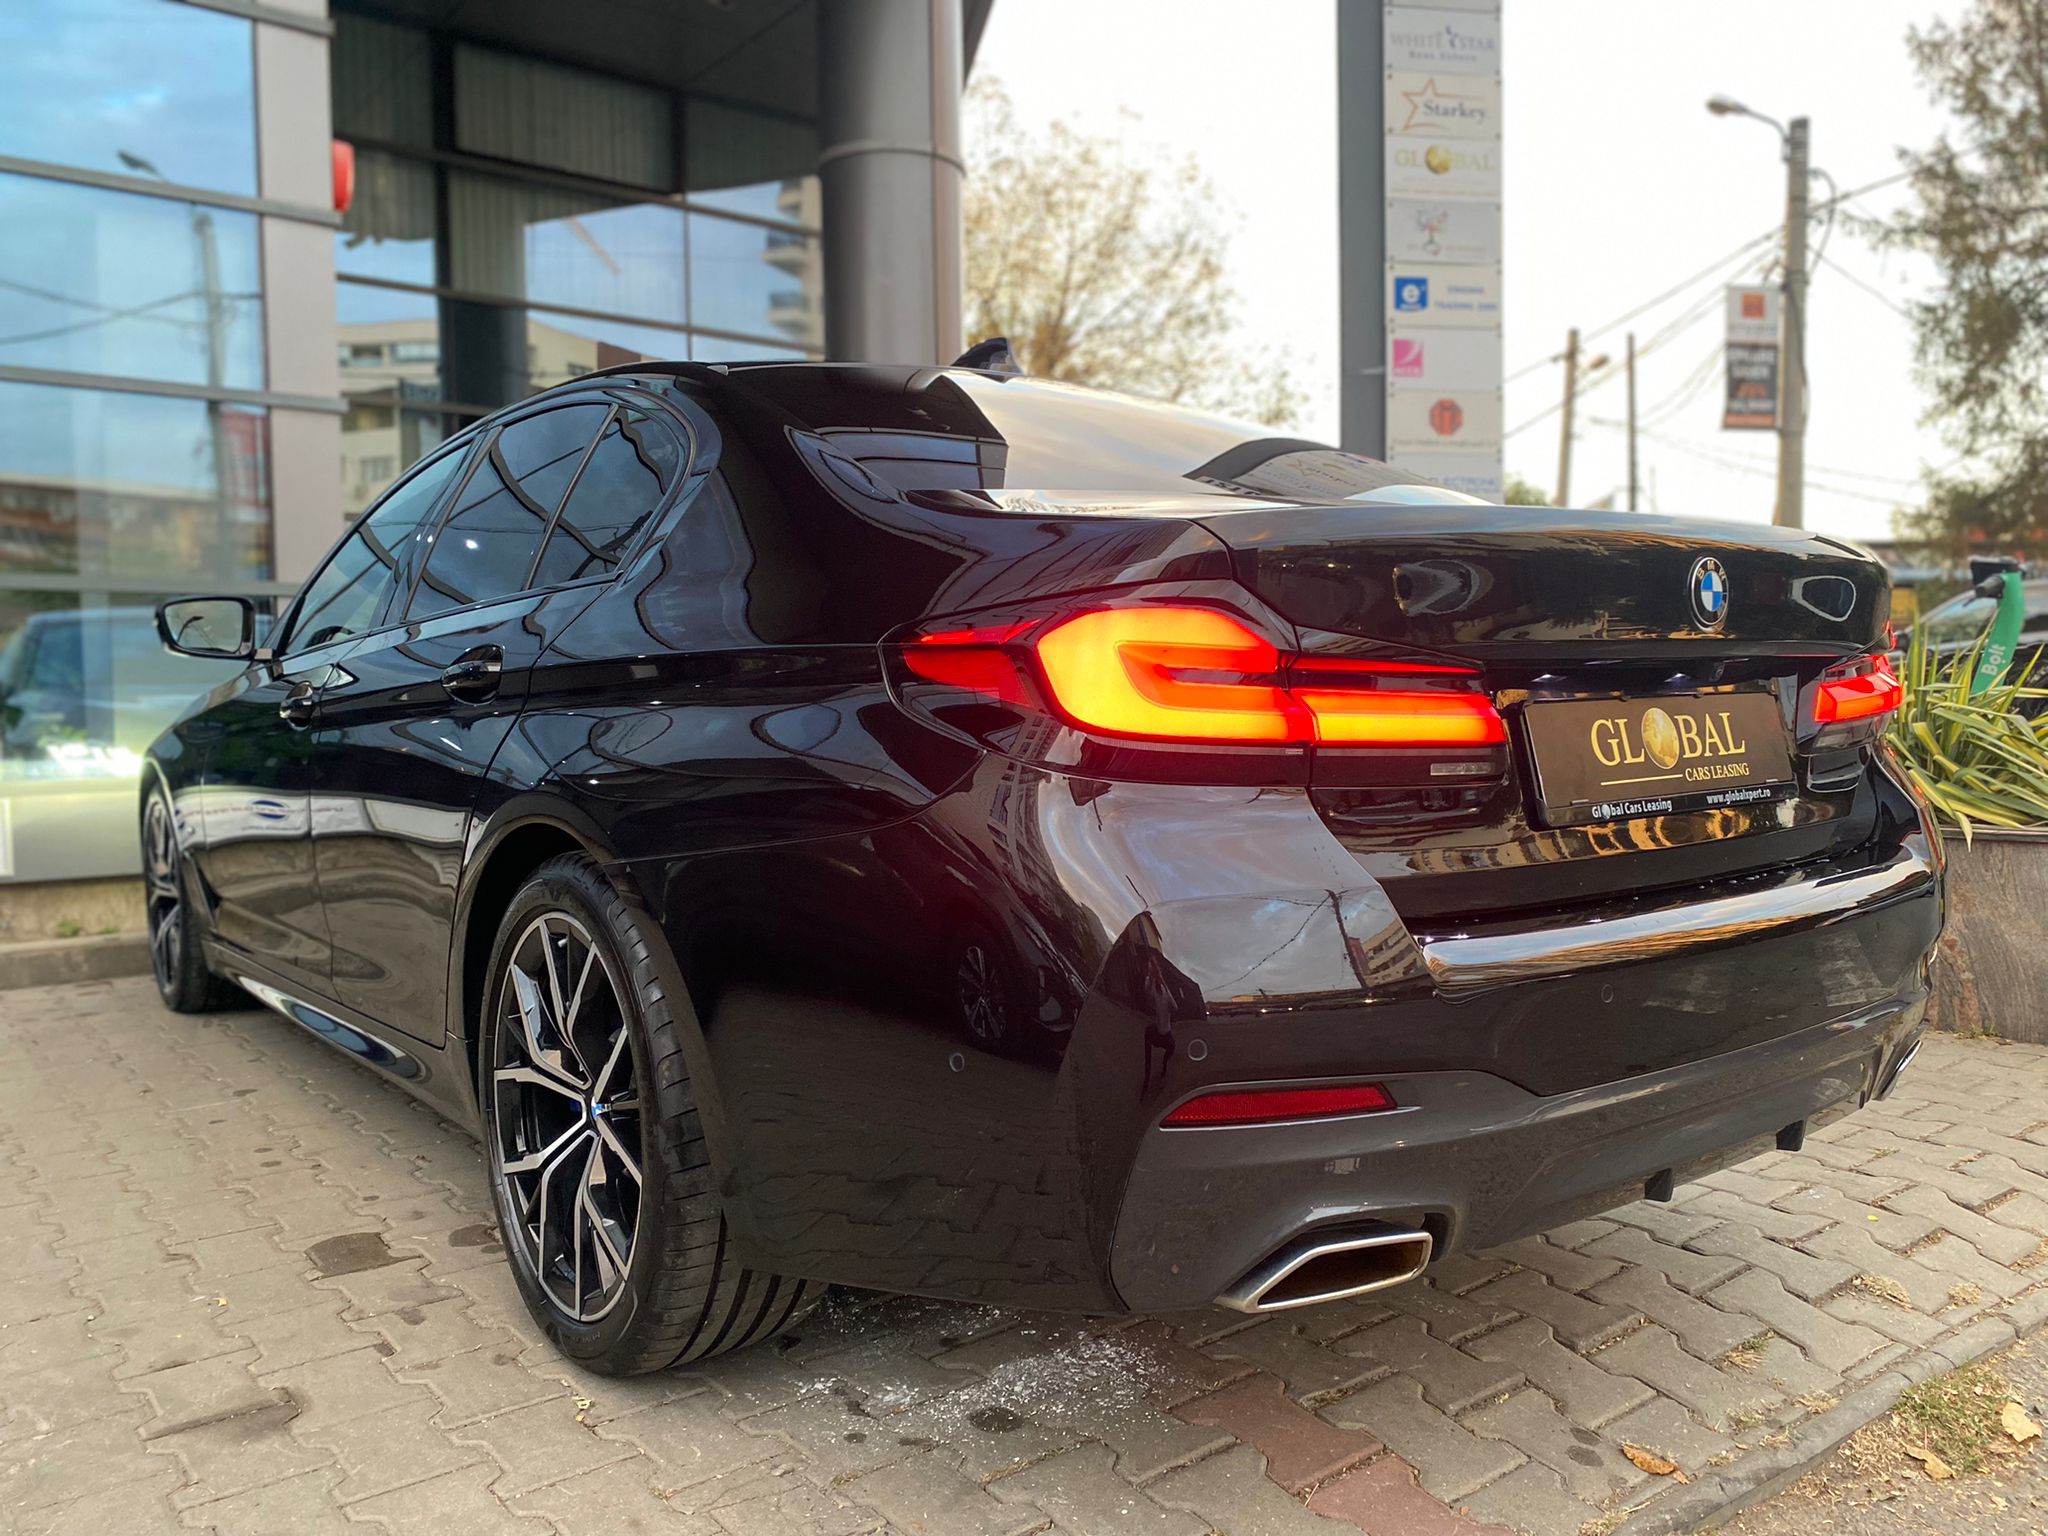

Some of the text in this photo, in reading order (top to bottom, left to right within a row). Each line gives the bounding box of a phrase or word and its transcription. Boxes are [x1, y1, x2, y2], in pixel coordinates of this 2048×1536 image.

[1423, 101, 1486, 124] Starkey
[1981, 643, 2006, 676] Bolt
[1590, 707, 1746, 770] GLOBAL
[1685, 763, 1750, 782] CARS LEASING
[1706, 787, 1771, 805] www.globalxpert.ro
[1624, 802, 1642, 815] Cars
[1643, 799, 1673, 813] Leasing
